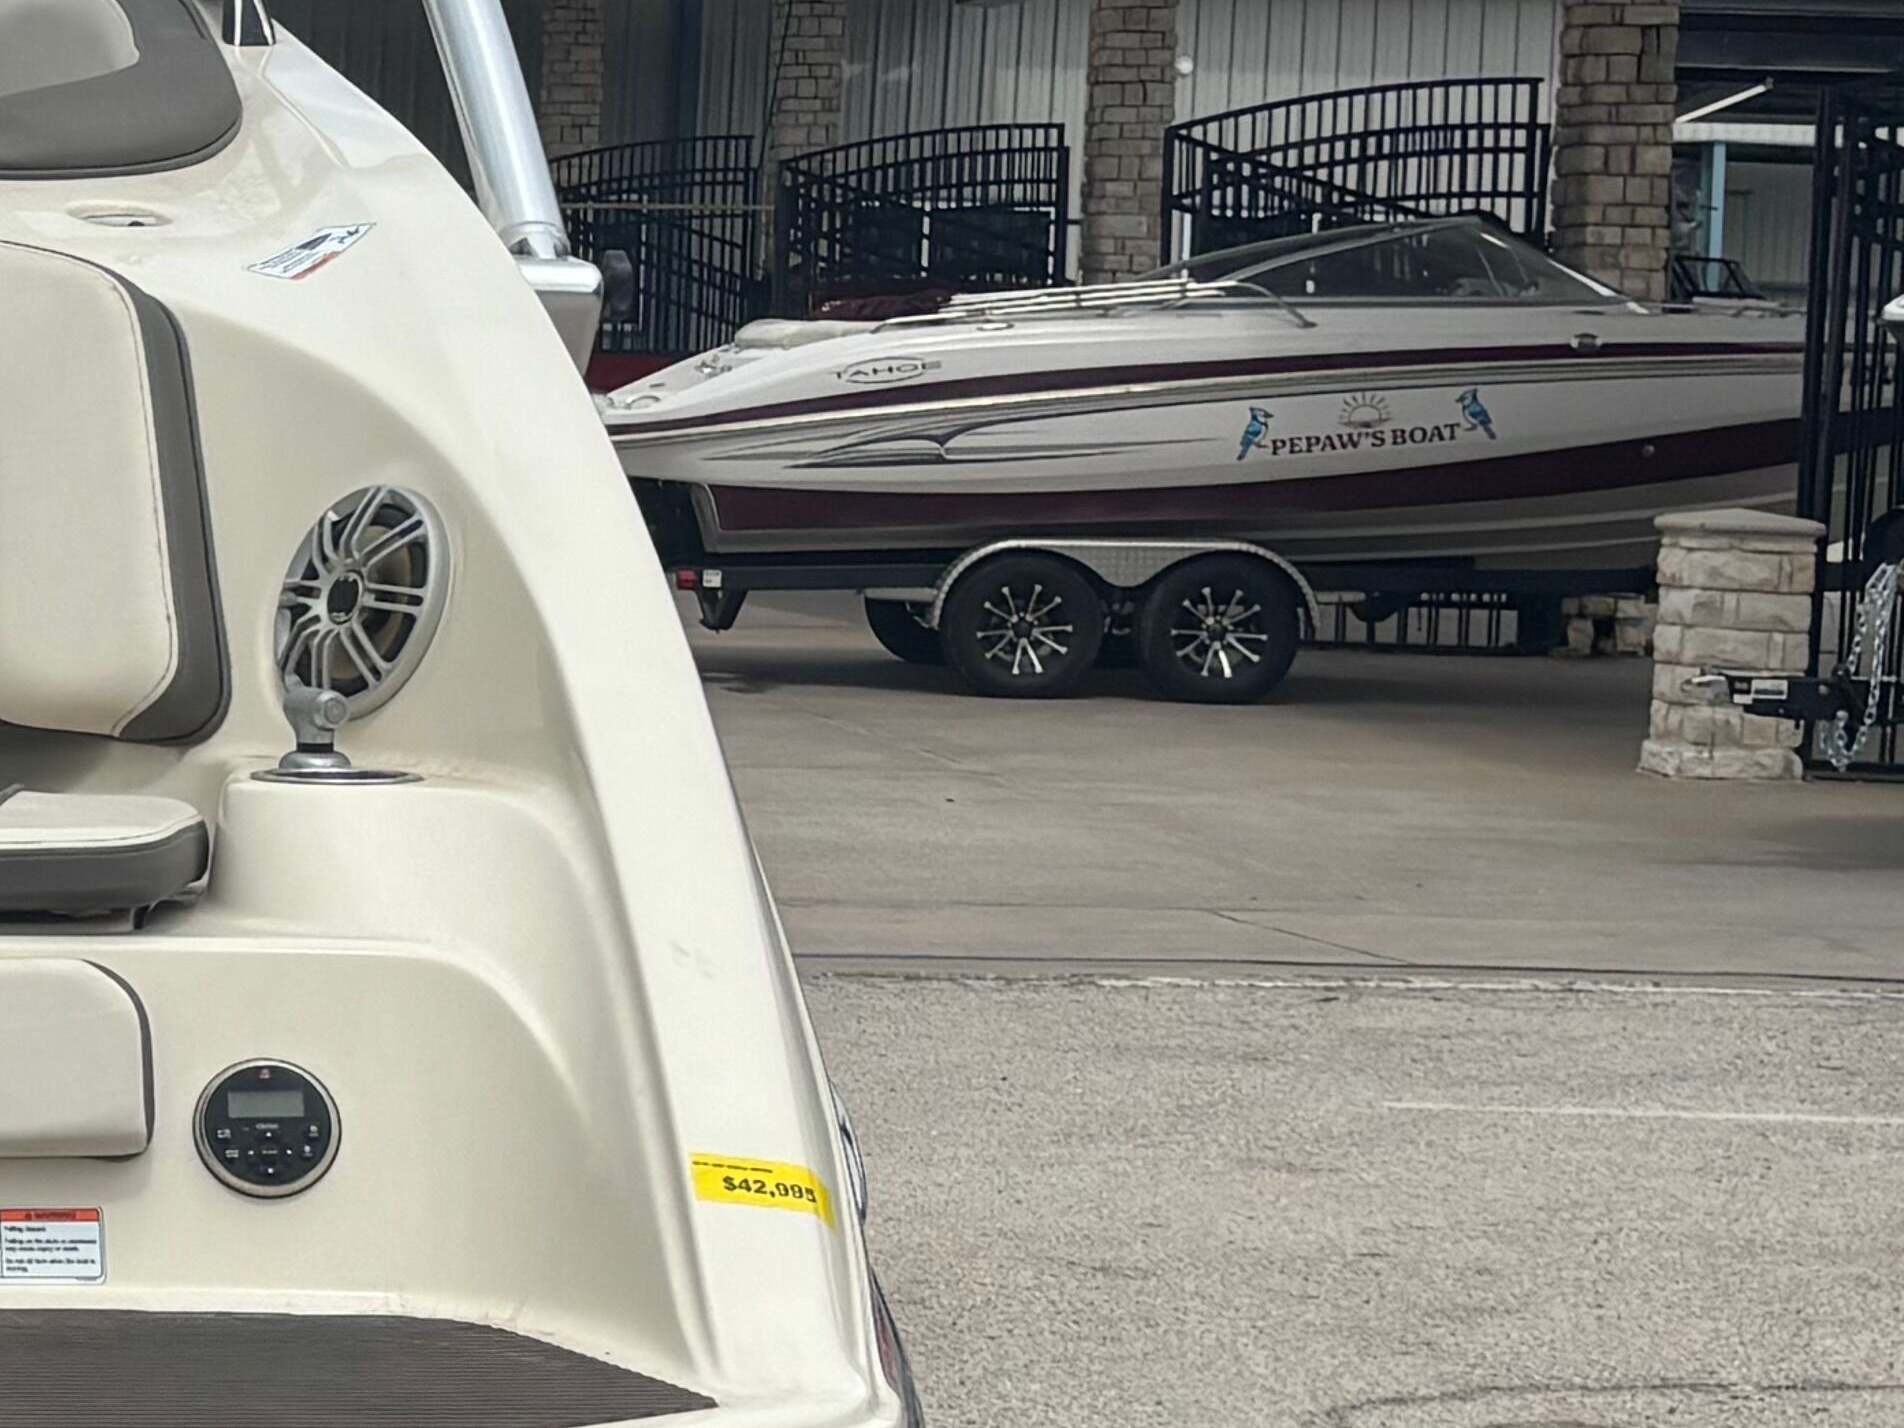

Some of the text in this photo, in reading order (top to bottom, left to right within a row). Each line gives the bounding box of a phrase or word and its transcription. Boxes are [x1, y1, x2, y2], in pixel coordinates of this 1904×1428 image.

[829, 359, 942, 379] TAHOE
[1270, 423, 1461, 456] PEPAW'S BOAT
